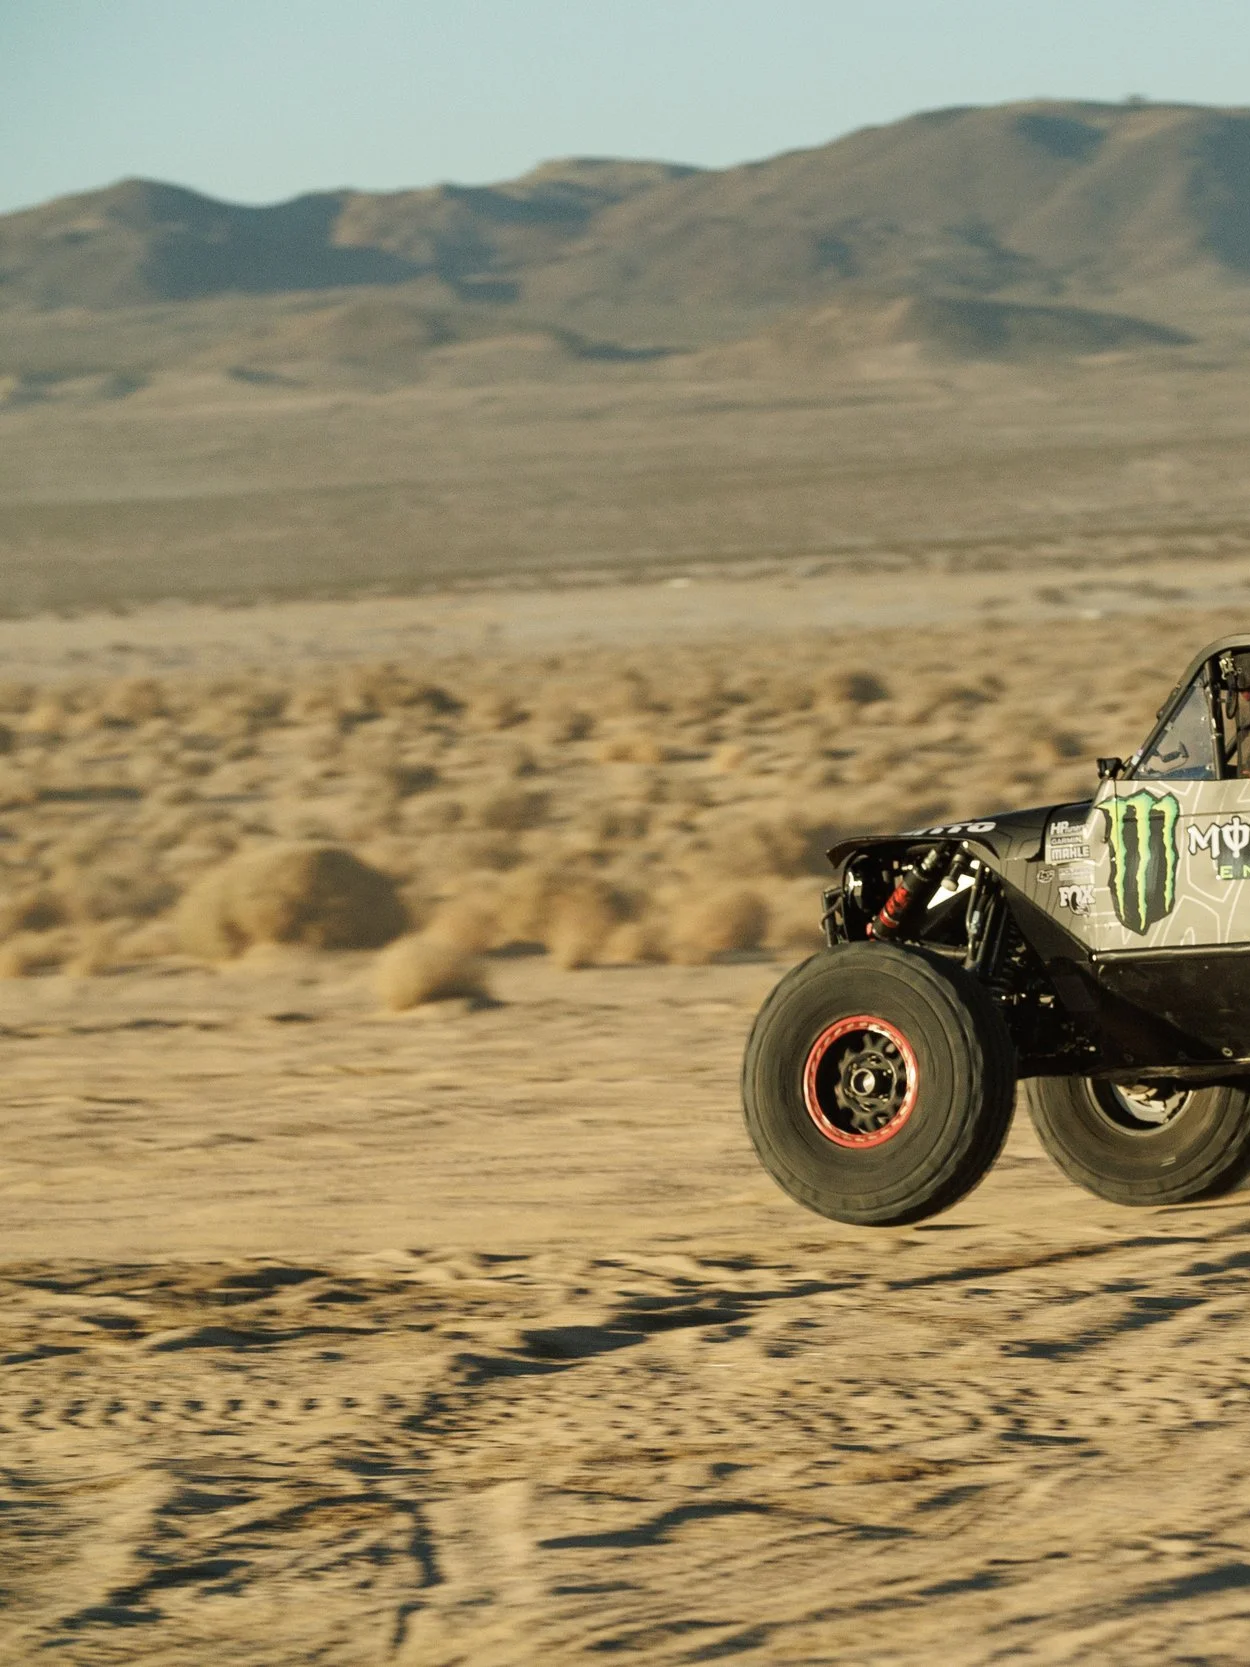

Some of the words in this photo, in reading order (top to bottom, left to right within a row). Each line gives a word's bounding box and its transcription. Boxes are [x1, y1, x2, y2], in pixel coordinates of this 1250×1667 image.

[1051, 836, 1082, 846] GARMIN
[1051, 846, 1090, 861] MAHLE
[1058, 885, 1096, 916] FOX
